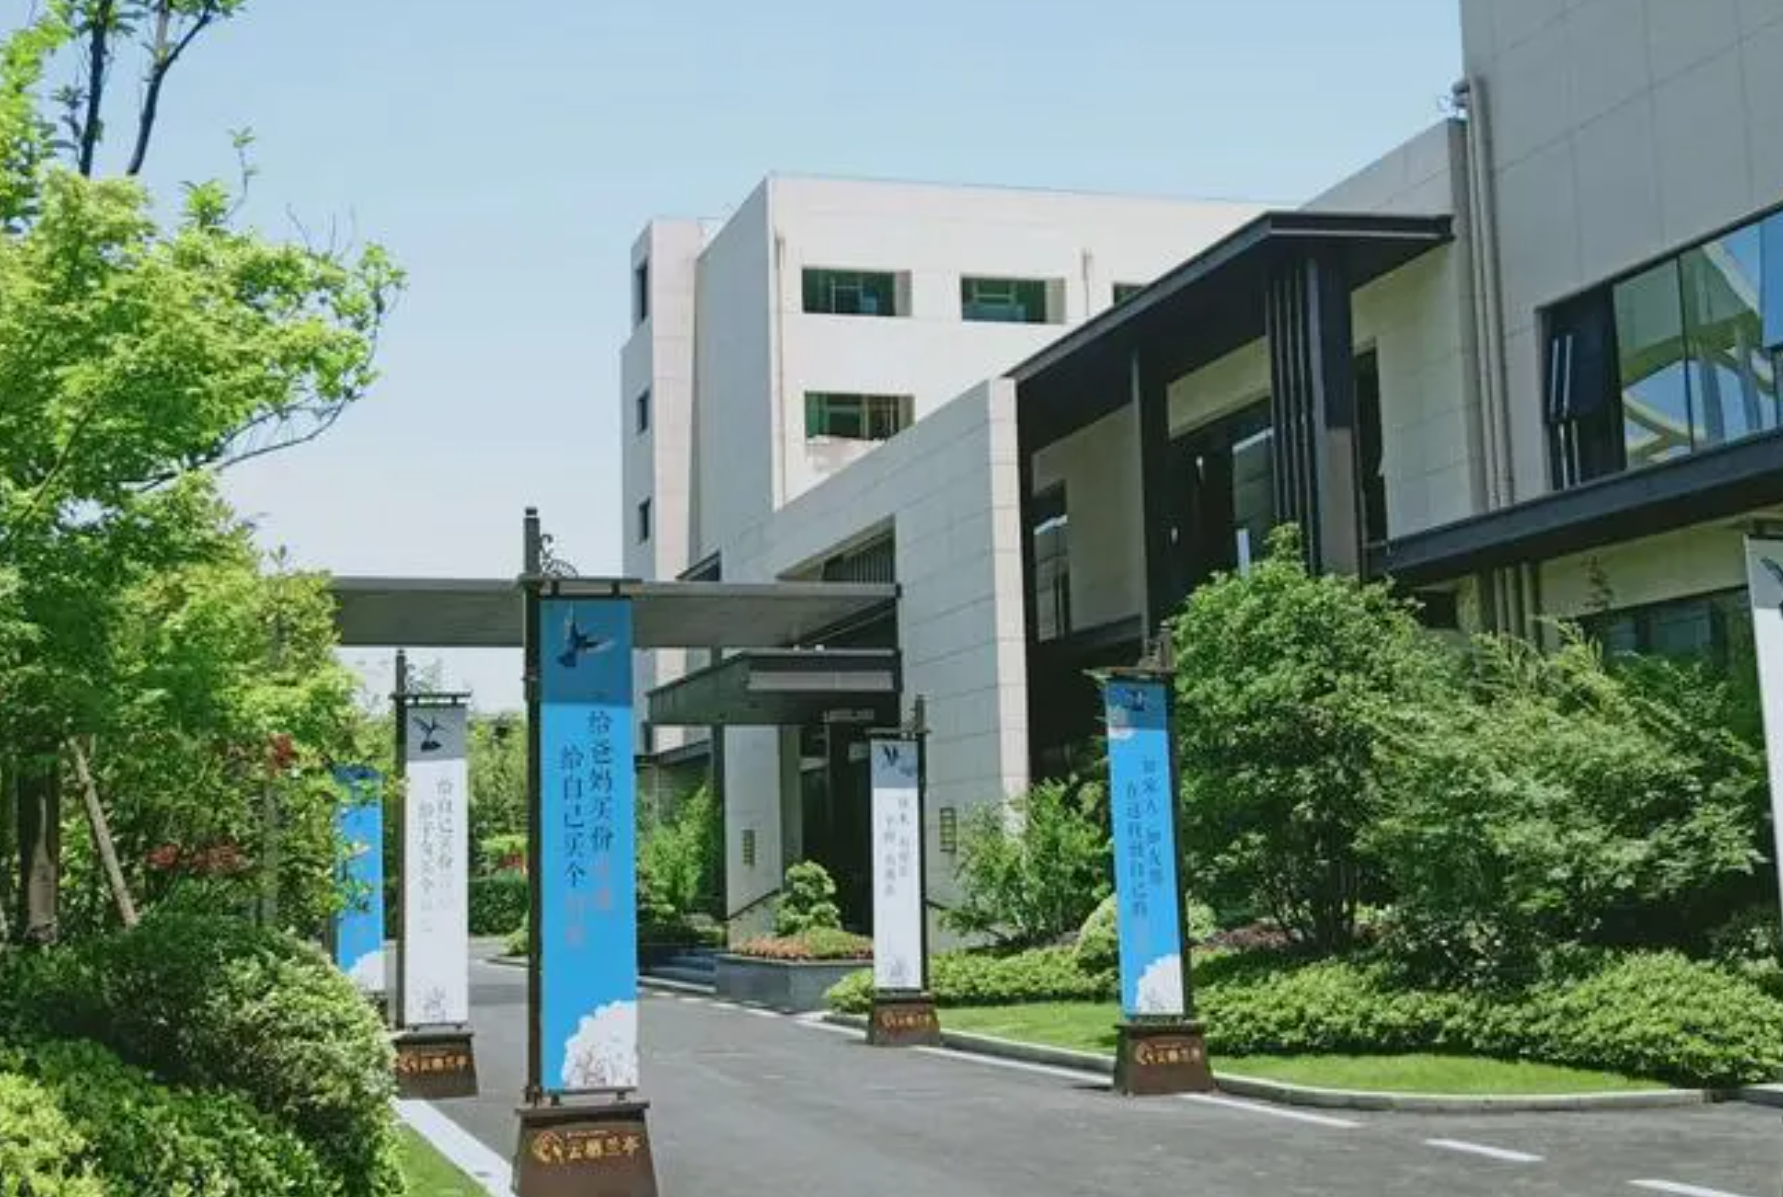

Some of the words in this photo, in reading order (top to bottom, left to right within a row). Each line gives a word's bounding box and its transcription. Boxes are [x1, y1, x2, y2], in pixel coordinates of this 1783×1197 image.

[436, 777, 455, 911] 给自己买份
[561, 743, 587, 946] 给自己买个
[586, 709, 614, 912] 给爸妈买份
[567, 1135, 641, 1160] 云兰亭
